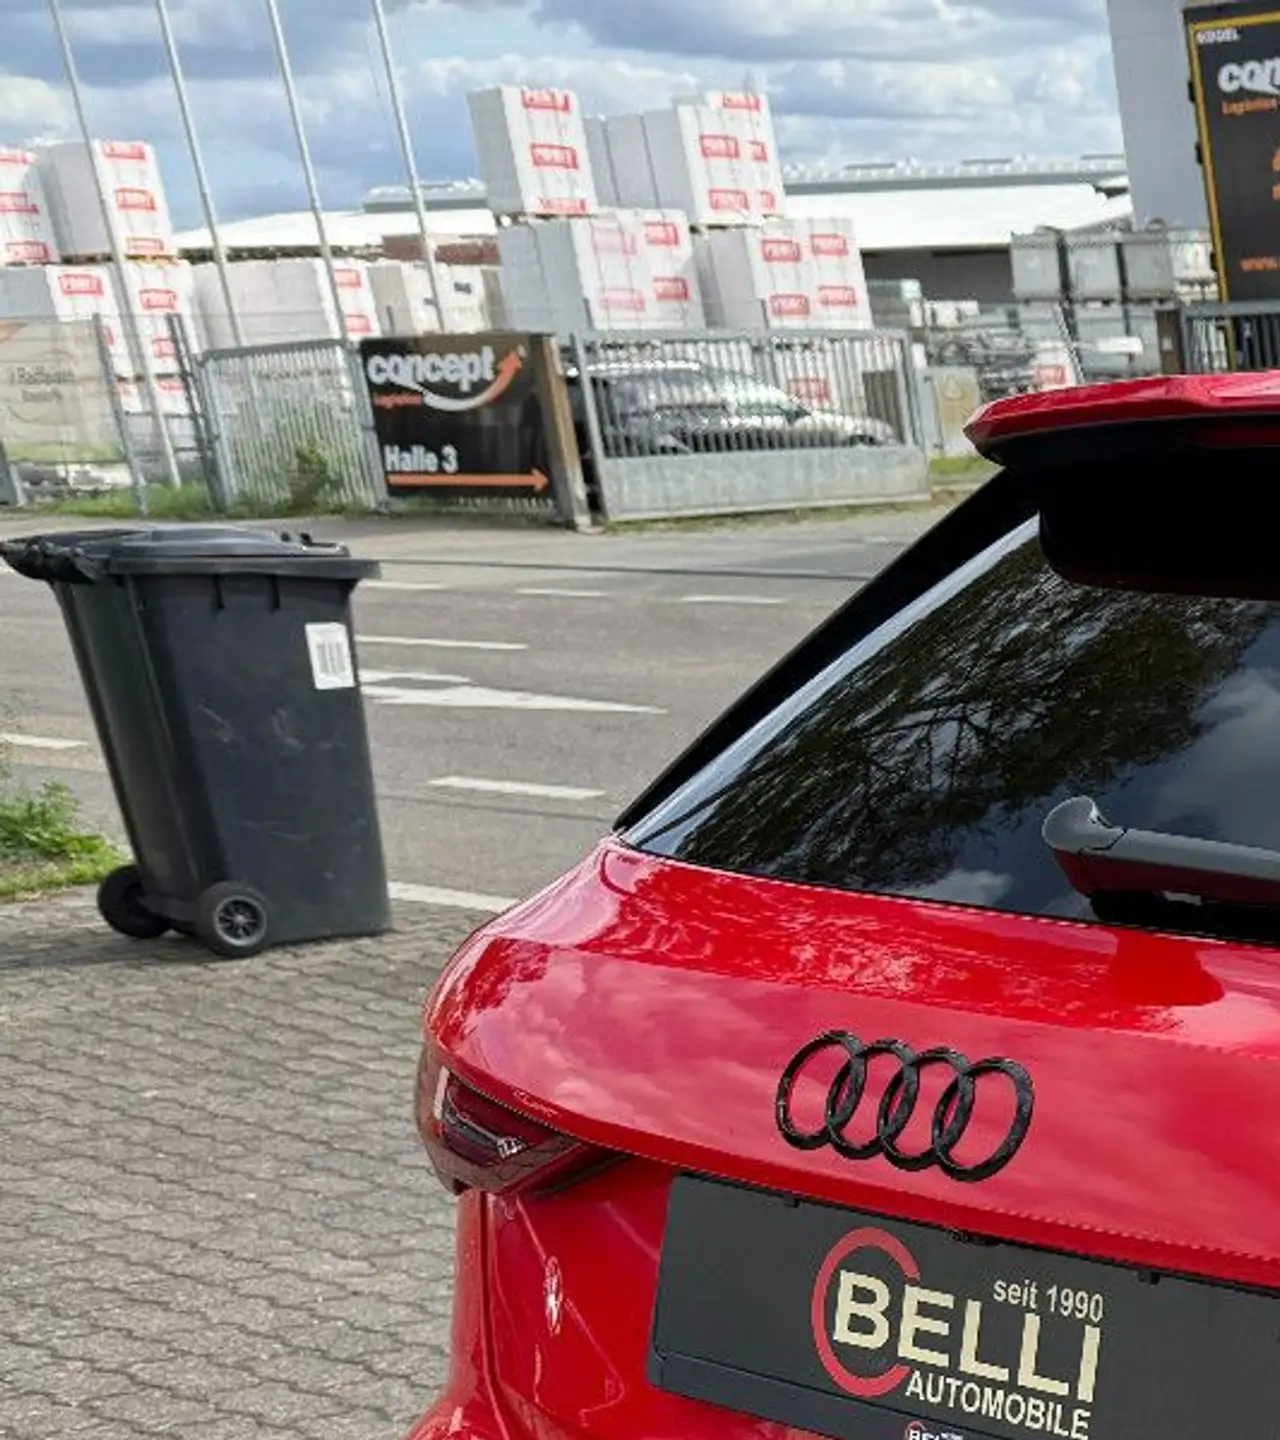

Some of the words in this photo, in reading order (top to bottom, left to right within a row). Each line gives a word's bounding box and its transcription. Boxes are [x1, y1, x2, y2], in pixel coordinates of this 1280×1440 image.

[367, 346, 496, 392] concept
[384, 444, 439, 472] Halle
[441, 444, 459, 474] 3
[993, 1279, 1038, 1309] seit
[1046, 1285, 1104, 1323] 1990
[832, 1268, 1101, 1403] BELLI
[905, 1370, 1092, 1440] AUTOMOBILE
